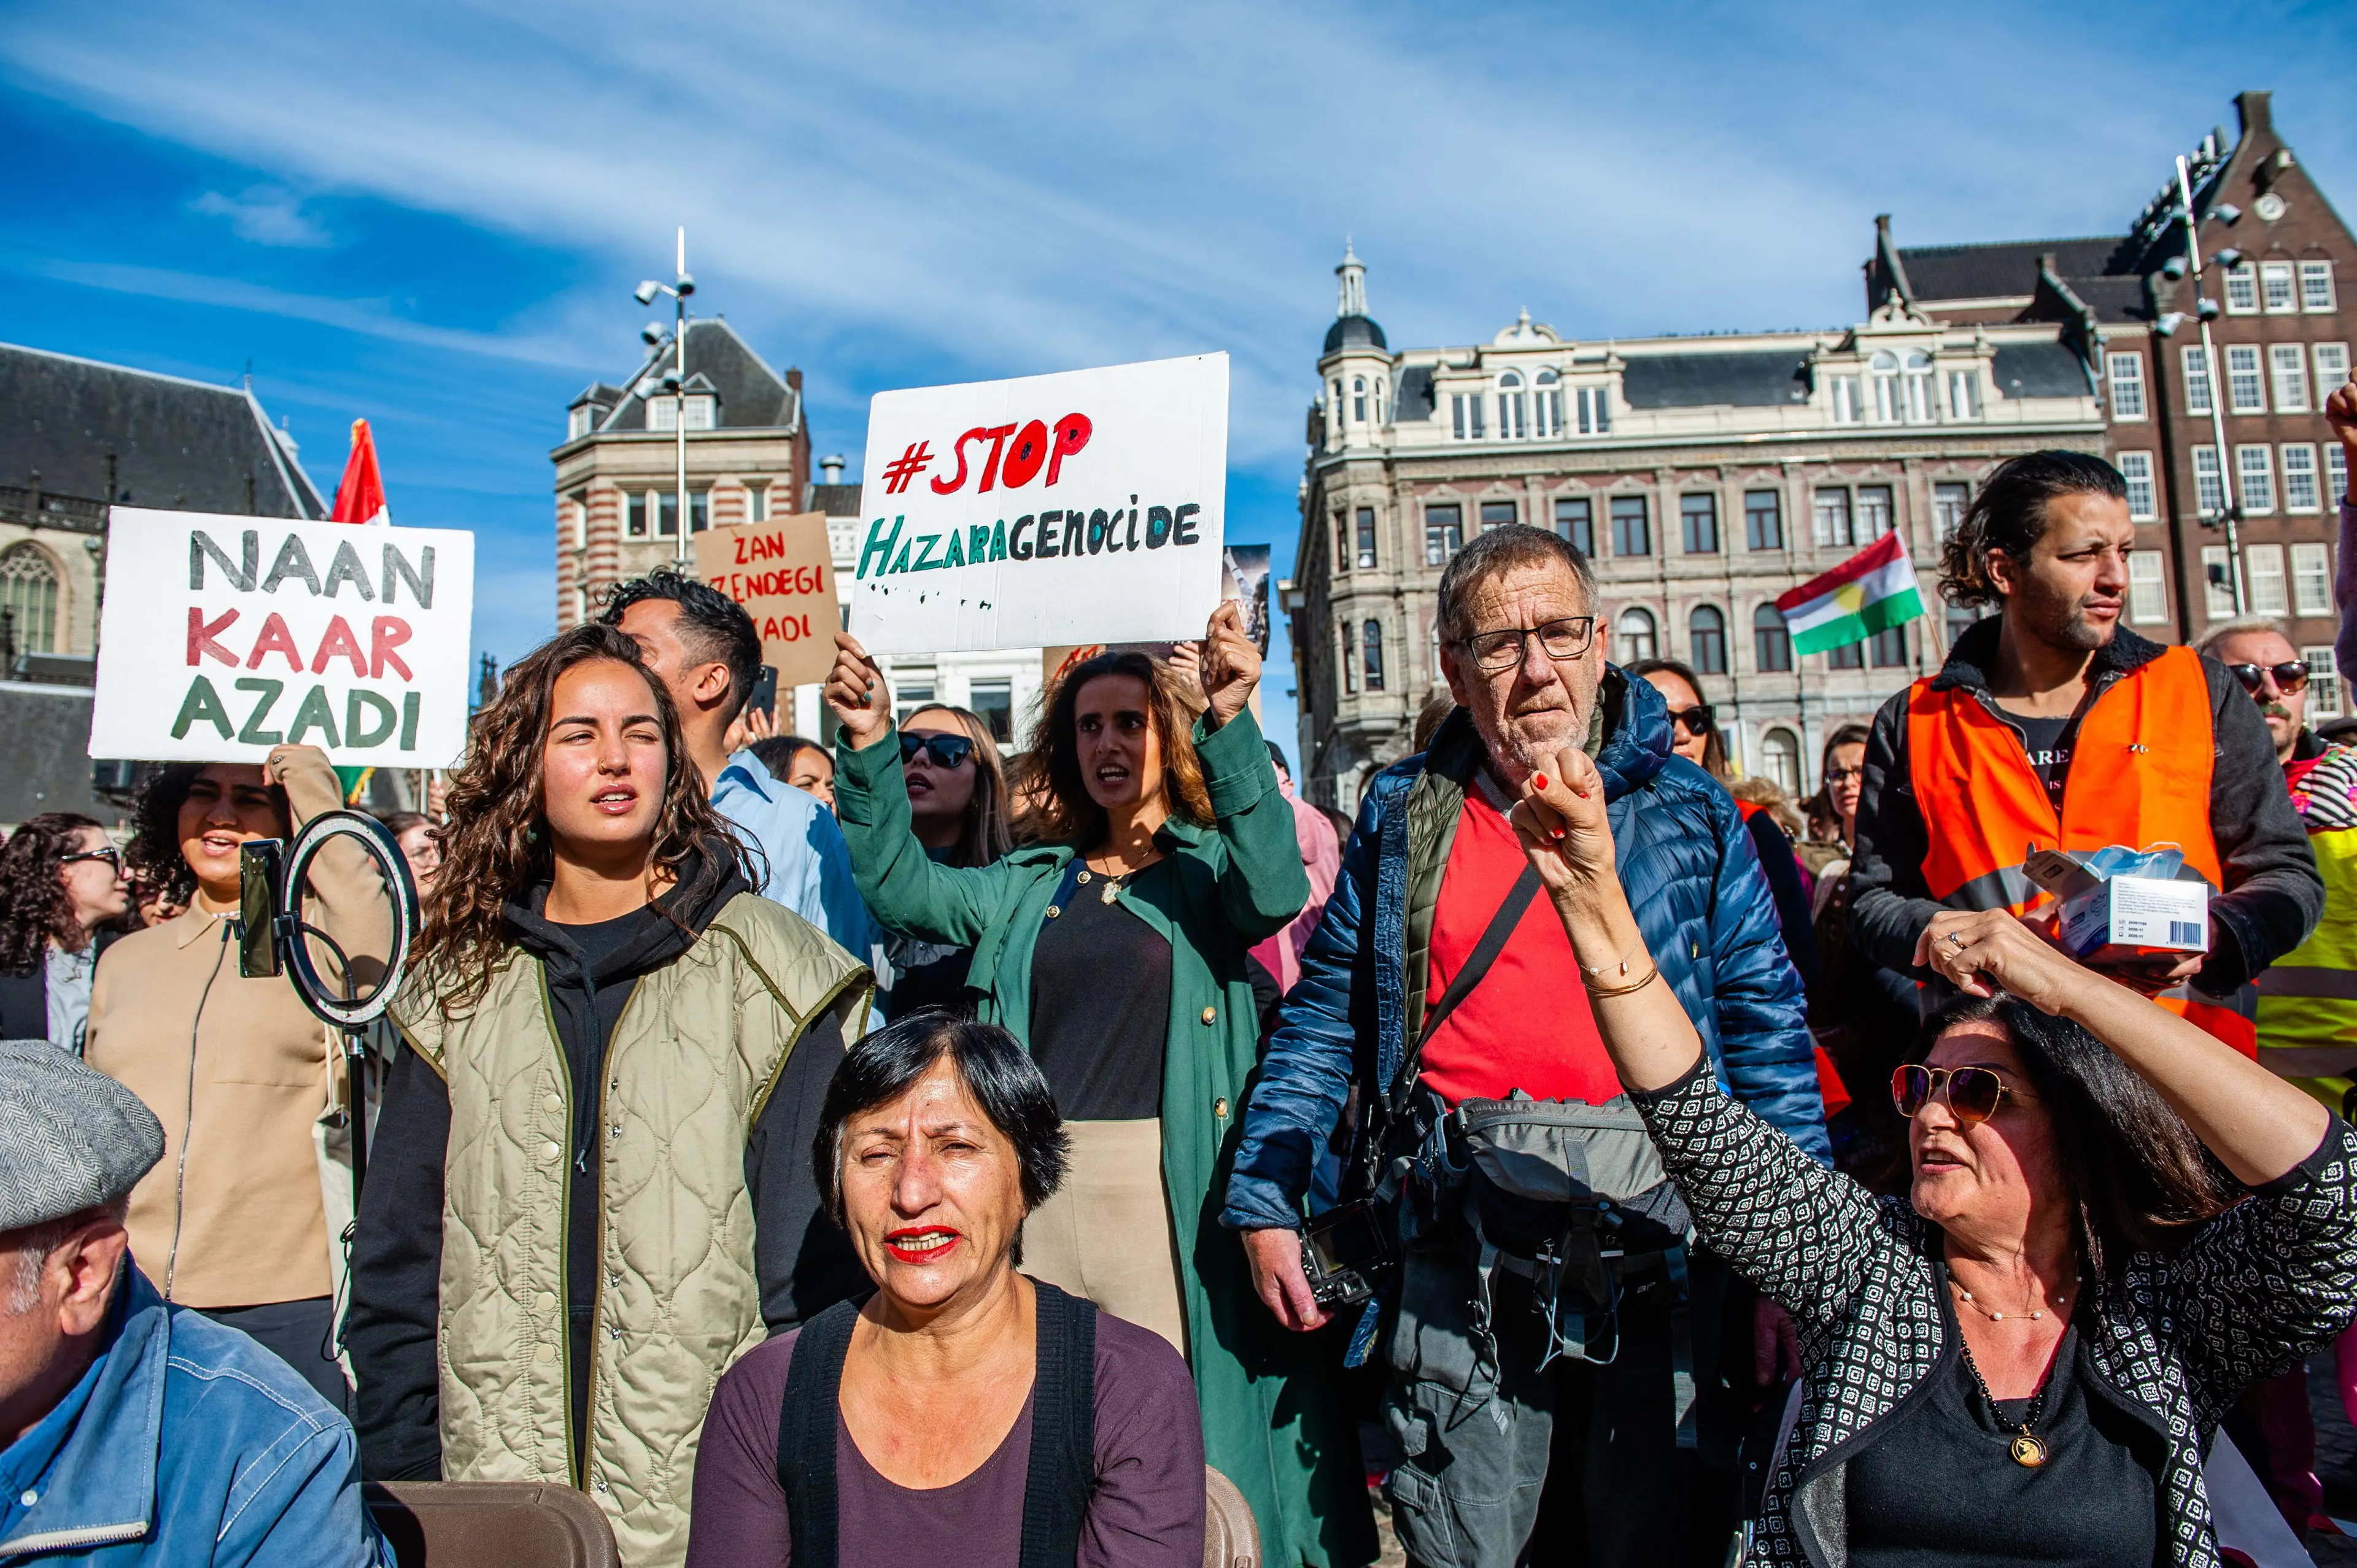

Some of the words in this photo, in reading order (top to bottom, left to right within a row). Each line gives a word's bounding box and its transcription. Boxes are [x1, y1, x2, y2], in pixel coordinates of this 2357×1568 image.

[882, 412, 1093, 495] #STOP
[190, 530, 435, 609] NAAN
[734, 531, 786, 565] ZAN
[187, 606, 413, 682] KAAR
[753, 614, 811, 642] ADI
[171, 674, 420, 751] AZADI
